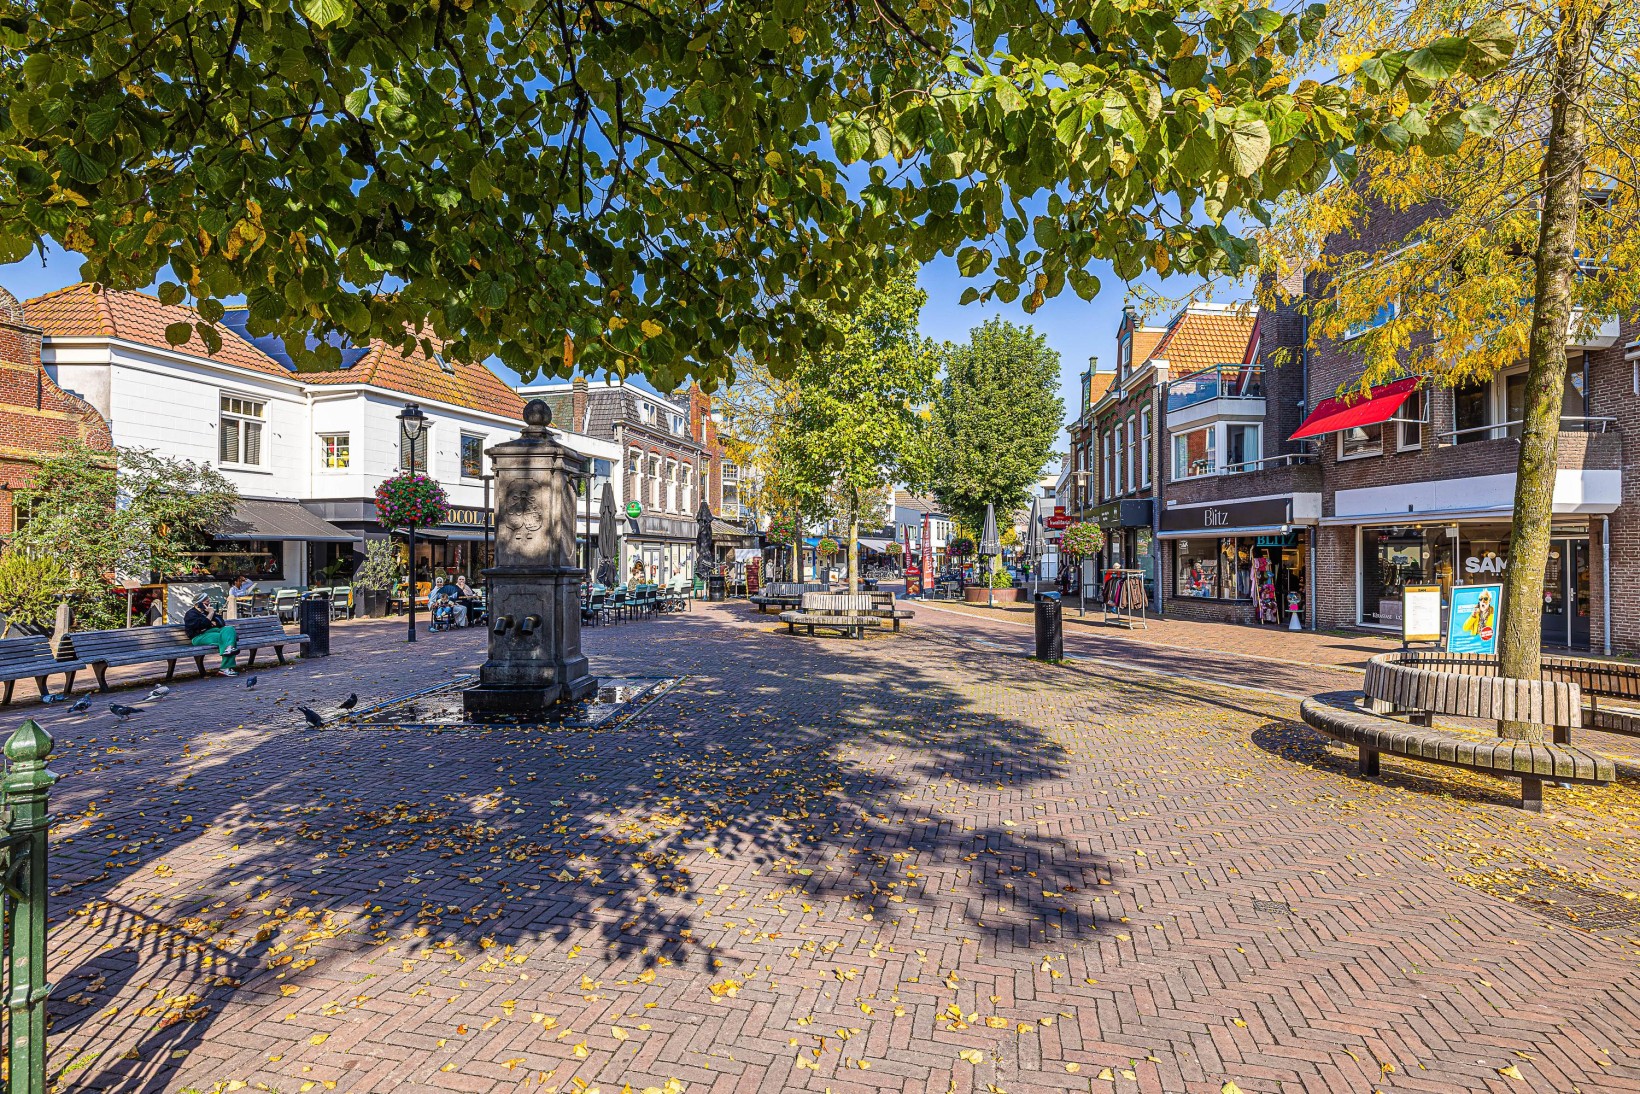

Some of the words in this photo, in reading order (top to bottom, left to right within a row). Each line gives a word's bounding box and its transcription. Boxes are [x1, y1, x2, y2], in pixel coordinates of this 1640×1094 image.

[446, 508, 495, 526] OCOLAT
[1204, 507, 1229, 527] Blitz
[1256, 533, 1297, 546] BLITZ
